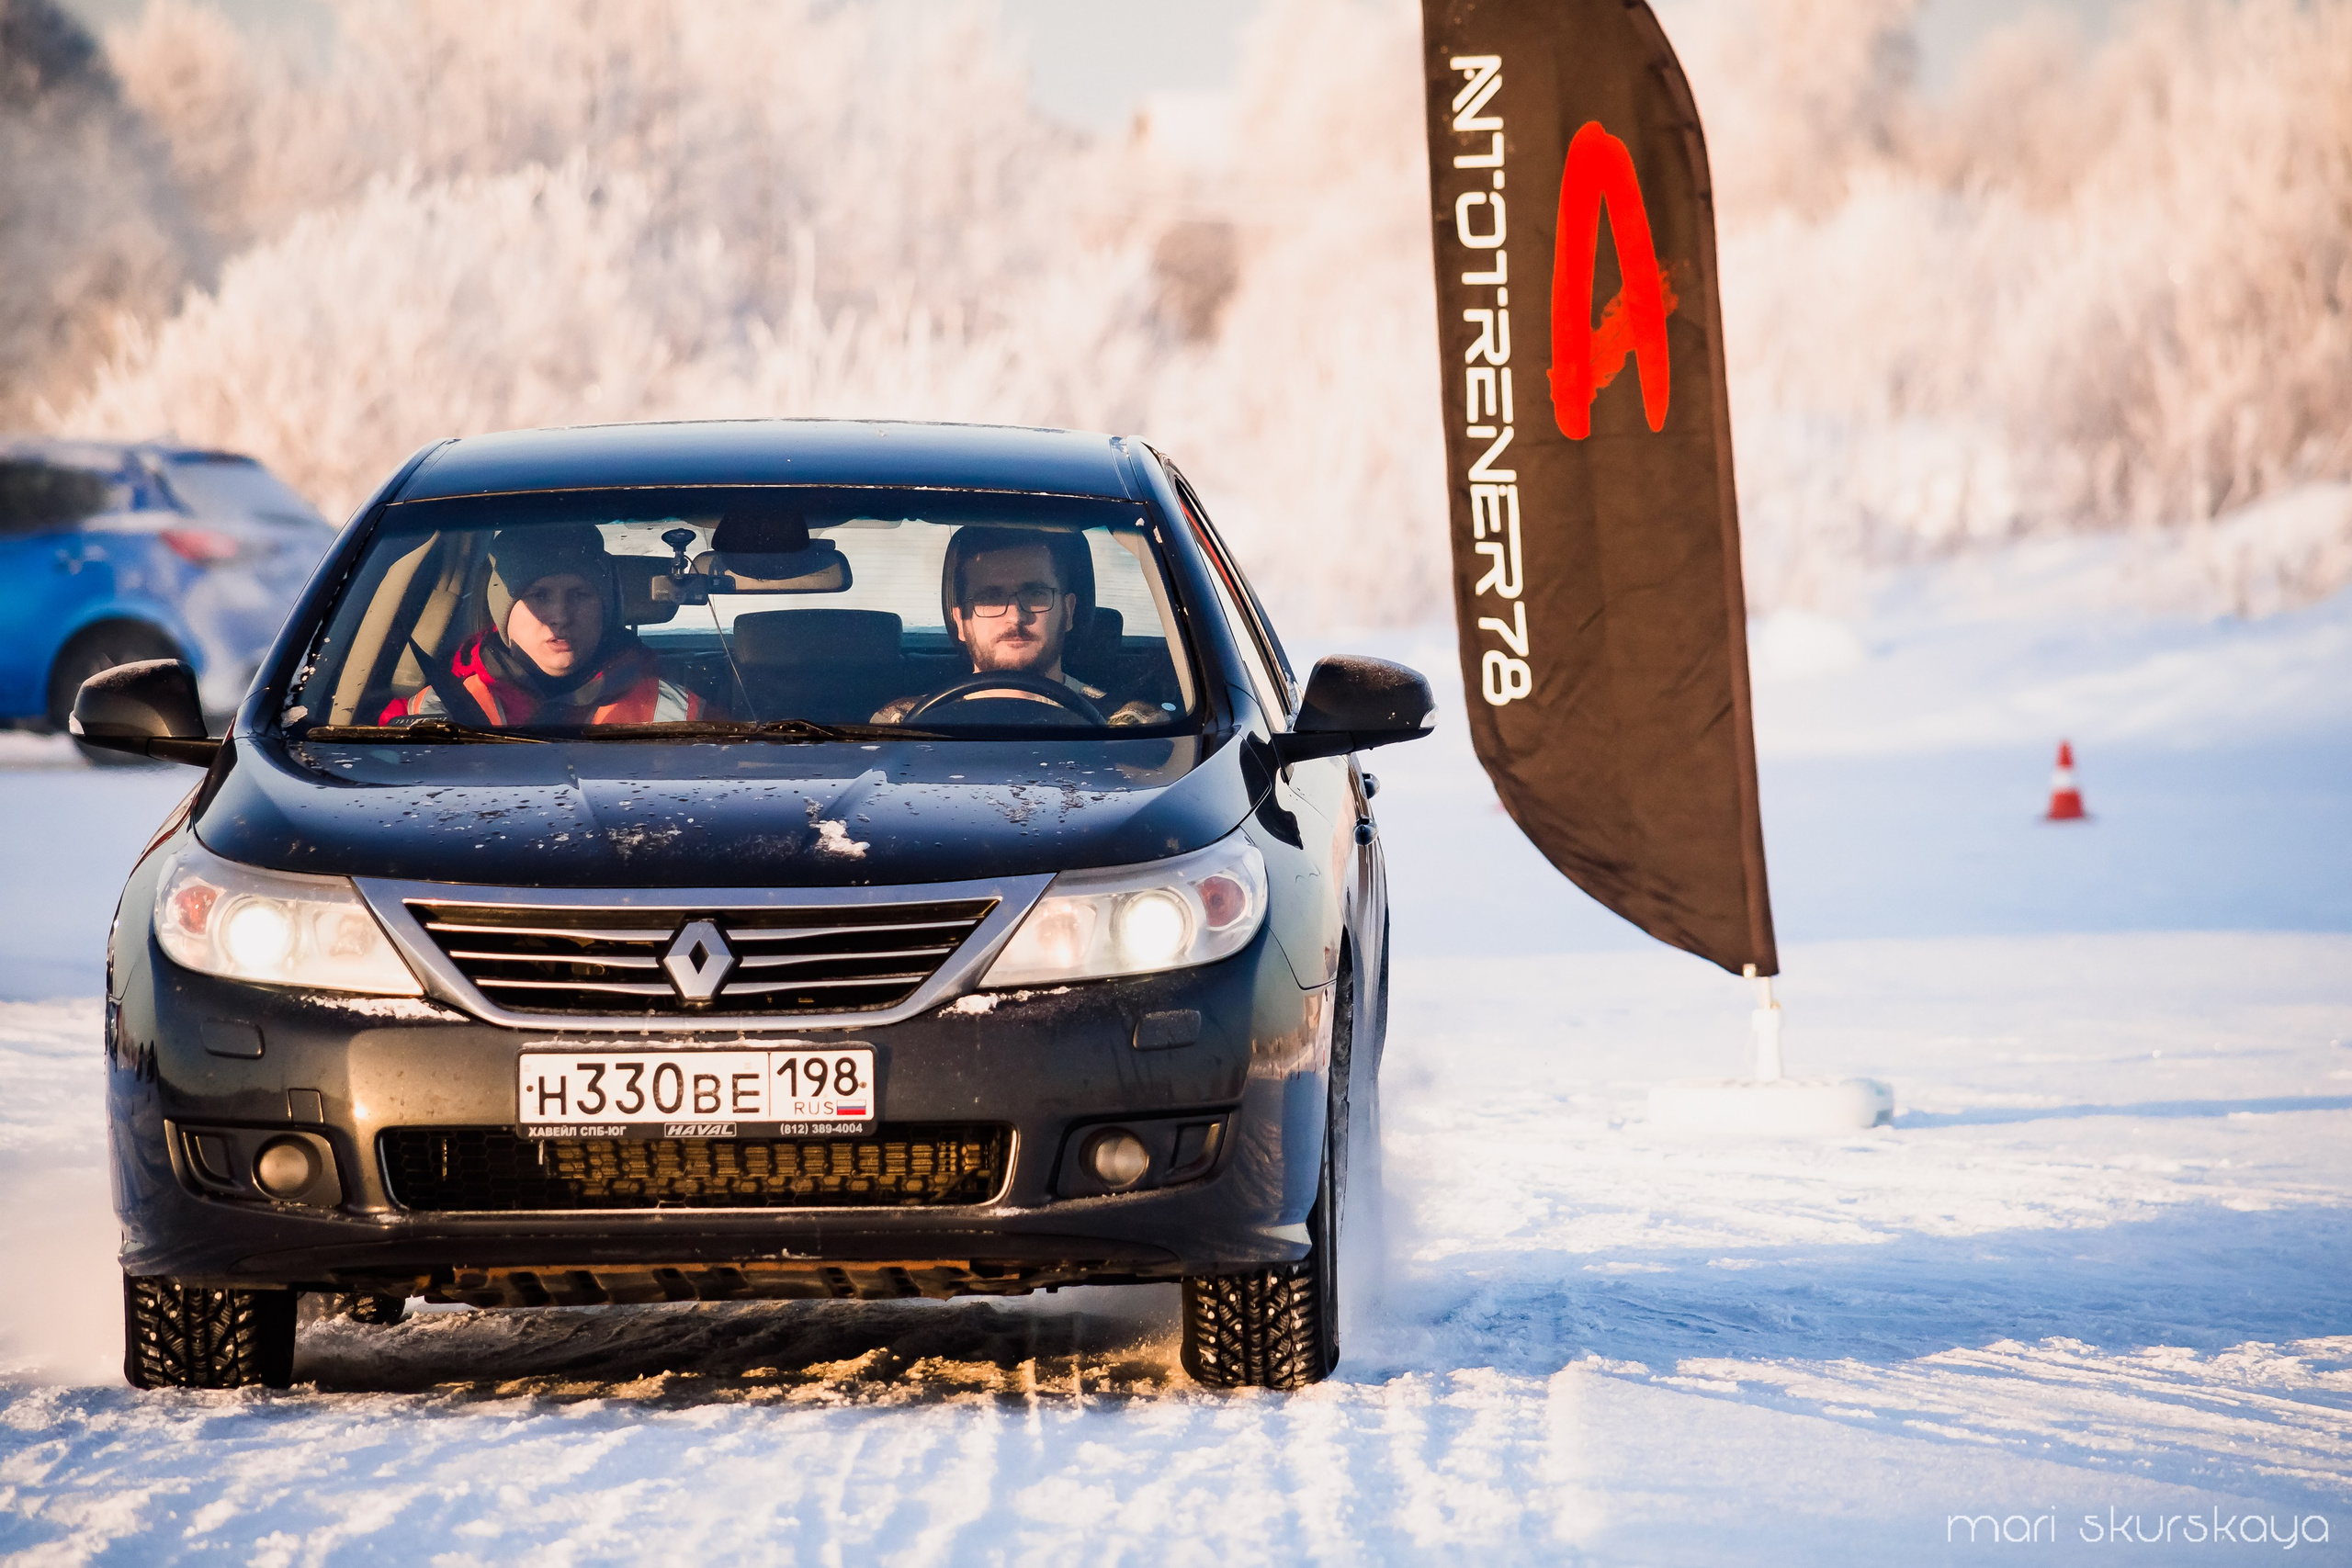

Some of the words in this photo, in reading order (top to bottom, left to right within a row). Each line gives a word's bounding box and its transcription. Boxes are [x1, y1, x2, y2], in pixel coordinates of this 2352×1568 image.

[776, 1056, 859, 1097] 198
[794, 1100, 834, 1115] RUS
[528, 1125, 577, 1137] ХАВЕЙЛ
[580, 1126, 627, 1136] СПБ-ЮГ
[668, 1124, 734, 1135] HAVAL
[780, 1122, 808, 1134] (812)
[812, 1122, 863, 1134] 389-4004
